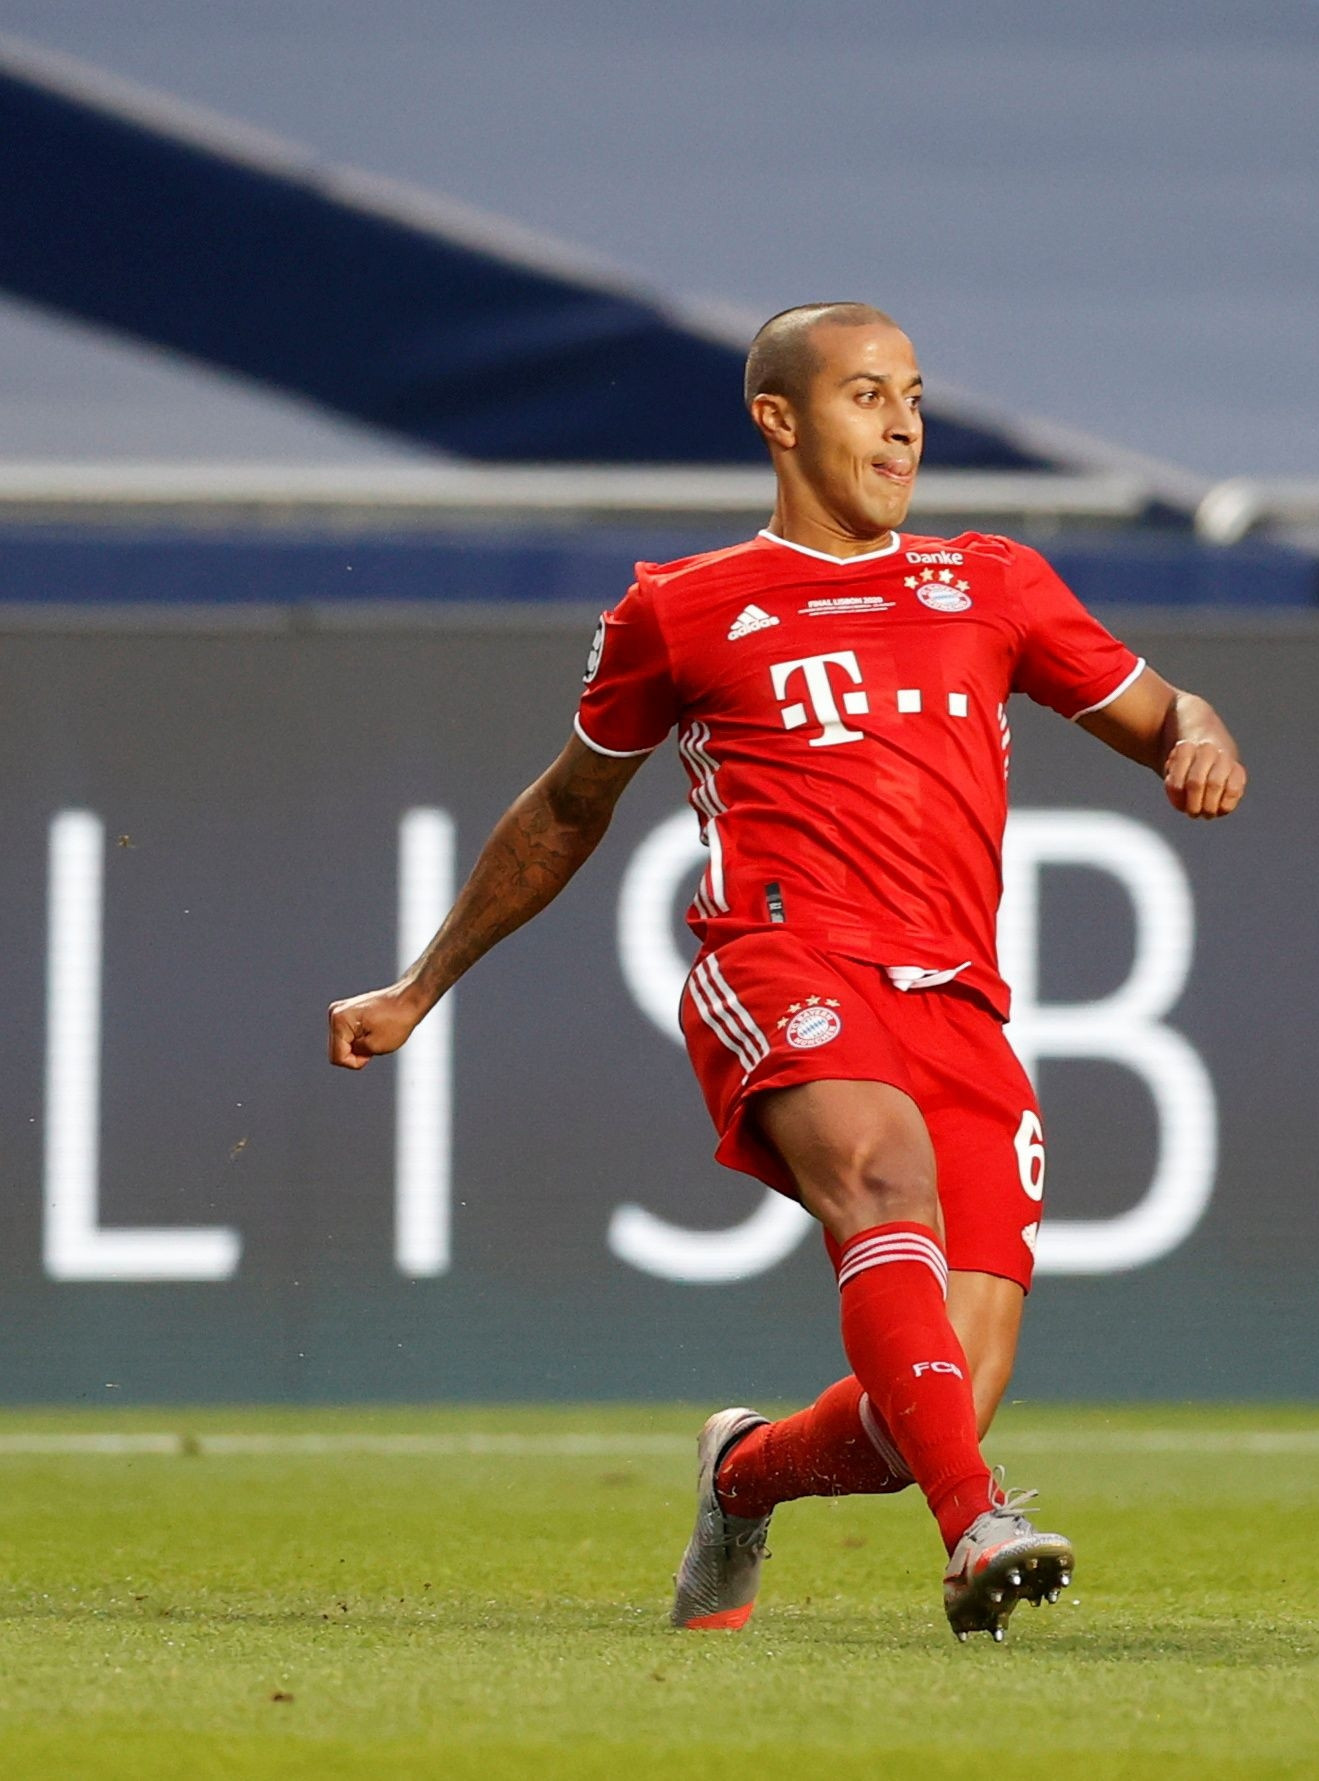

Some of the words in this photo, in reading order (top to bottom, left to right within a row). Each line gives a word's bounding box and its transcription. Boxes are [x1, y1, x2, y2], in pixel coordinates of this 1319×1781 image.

[905, 551, 964, 566] Danke
[727, 615, 780, 641] adidas
[769, 650, 868, 747] T
[1013, 1109, 1046, 1201] 6
